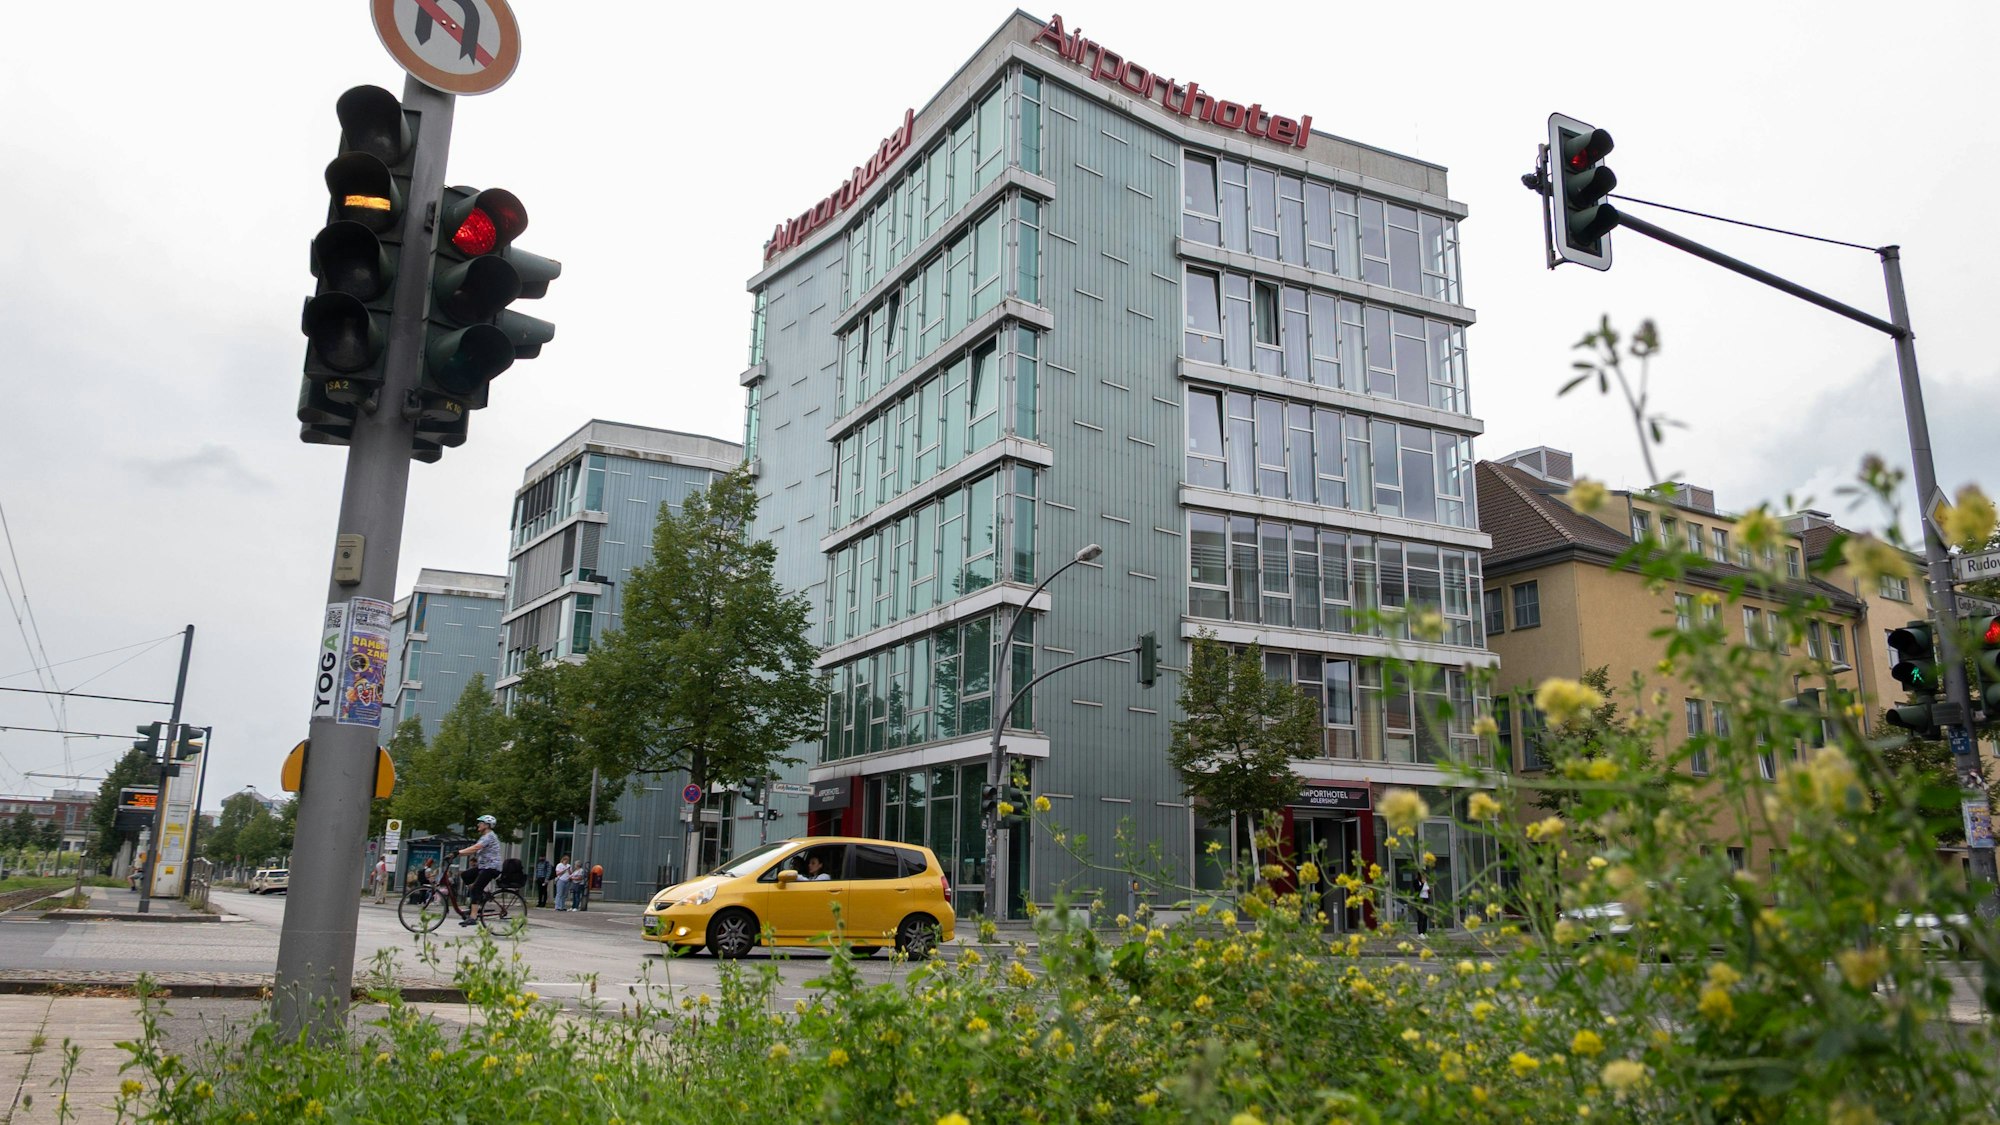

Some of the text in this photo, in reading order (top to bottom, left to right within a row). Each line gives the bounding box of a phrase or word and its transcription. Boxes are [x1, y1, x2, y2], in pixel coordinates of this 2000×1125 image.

[1032, 13, 1312, 149] Airporthotel
[765, 107, 914, 261] Airporthotel
[315, 633, 339, 711] YOGA
